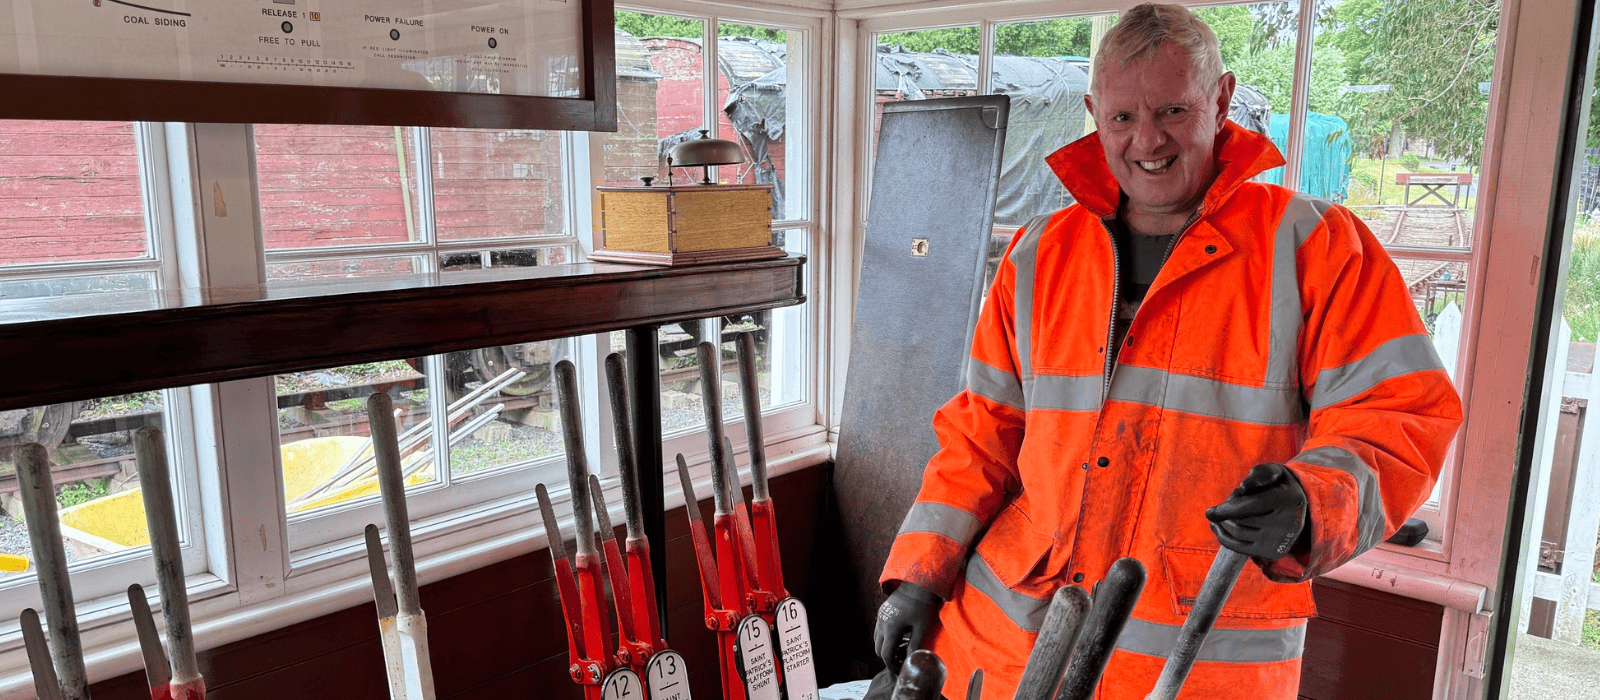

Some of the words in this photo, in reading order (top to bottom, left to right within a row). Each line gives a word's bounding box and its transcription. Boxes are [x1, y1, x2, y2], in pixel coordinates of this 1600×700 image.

[123, 15, 149, 25] COAL
[154, 17, 186, 27] SIDING
[262, 8, 297, 18] RELEASE
[364, 14, 390, 23] POWER
[395, 17, 424, 27] FAILURE
[471, 25, 495, 33] POWER
[258, 36, 279, 45] FREE
[284, 38, 295, 46] TO
[301, 39, 321, 47] PULL
[782, 602, 798, 622] 16
[745, 619, 760, 641] 15
[782, 640, 808, 656] PATRICK'S
[786, 634, 802, 646] SAINT
[750, 652, 766, 665] SAINT
[783, 648, 810, 664] PLATFORM
[655, 655, 677, 679] 13
[746, 659, 772, 677] PATRICK'S
[786, 657, 810, 673] STARTER
[747, 667, 773, 684] PLATFORM
[612, 675, 630, 699] 12
[752, 677, 770, 691] SHUNT
